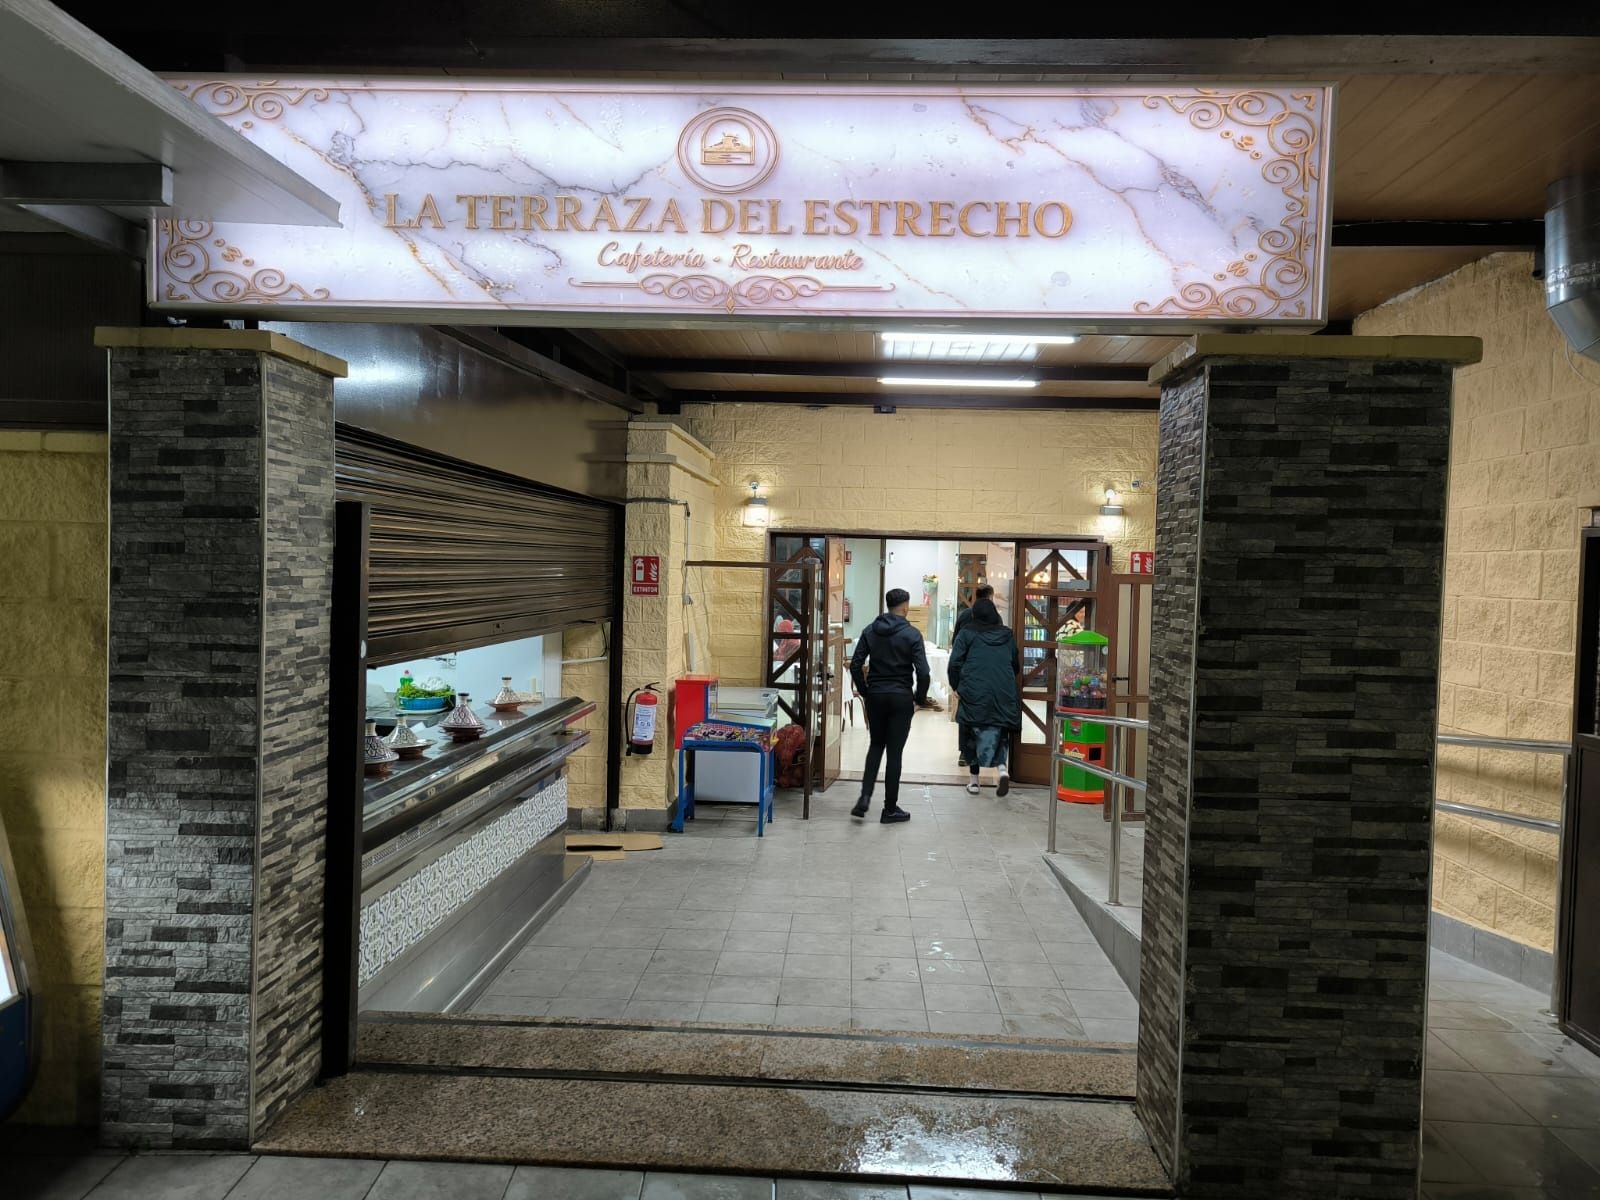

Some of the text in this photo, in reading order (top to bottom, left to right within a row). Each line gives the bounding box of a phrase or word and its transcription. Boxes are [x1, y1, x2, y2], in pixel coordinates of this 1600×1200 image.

[383, 193, 1074, 238] LA TERRAZA DEL ESTRECHO
[597, 241, 863, 273] Cafetería Restaurante
